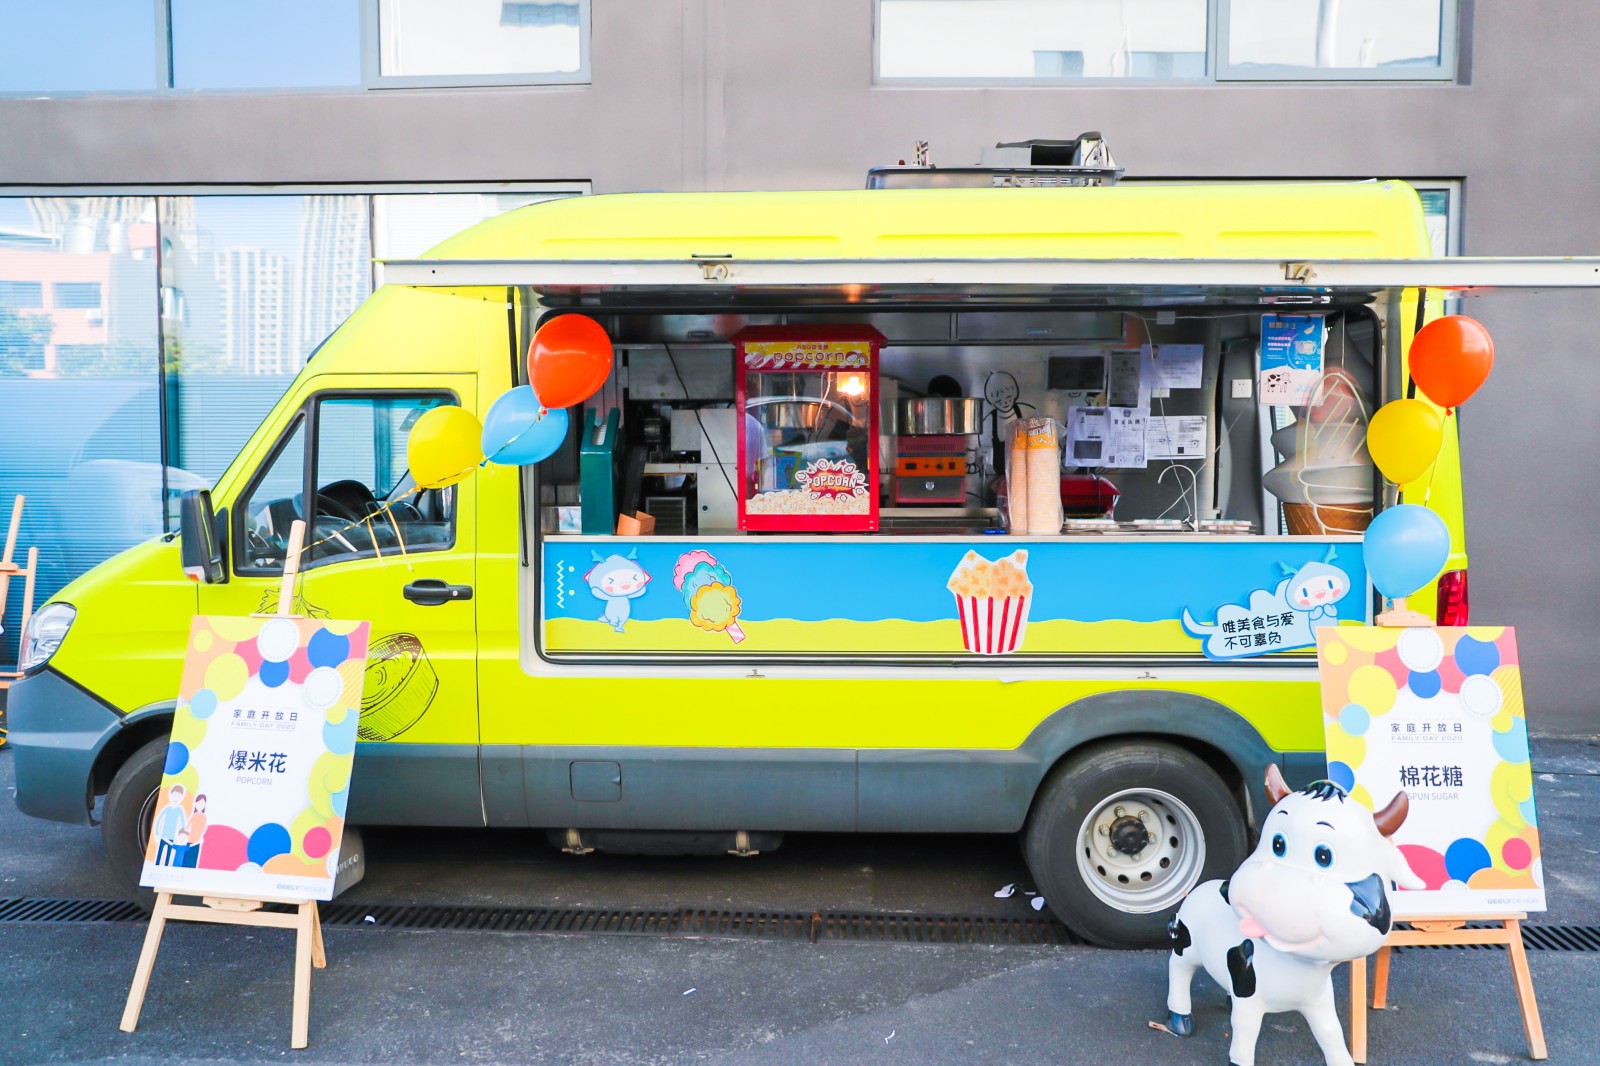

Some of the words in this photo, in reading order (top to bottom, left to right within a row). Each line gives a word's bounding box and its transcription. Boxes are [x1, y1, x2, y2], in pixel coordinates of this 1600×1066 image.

[773, 352, 845, 363] popcorn
[806, 474, 857, 489] POPCORN
[1222, 611, 1295, 634] 唯美食与爱
[1224, 630, 1282, 651] 不可辜负
[232, 709, 298, 721] 家庭开放日
[231, 721, 257, 729] FAMILY
[276, 723, 297, 731] 2020
[1390, 722, 1462, 733] 家庭开放日
[228, 749, 288, 774] 爆米花
[236, 776, 273, 786] POPCORN
[1399, 765, 1463, 787] 棉花糖
[1407, 792, 1430, 801] SPUN
[1431, 792, 1459, 801] SUGAR
